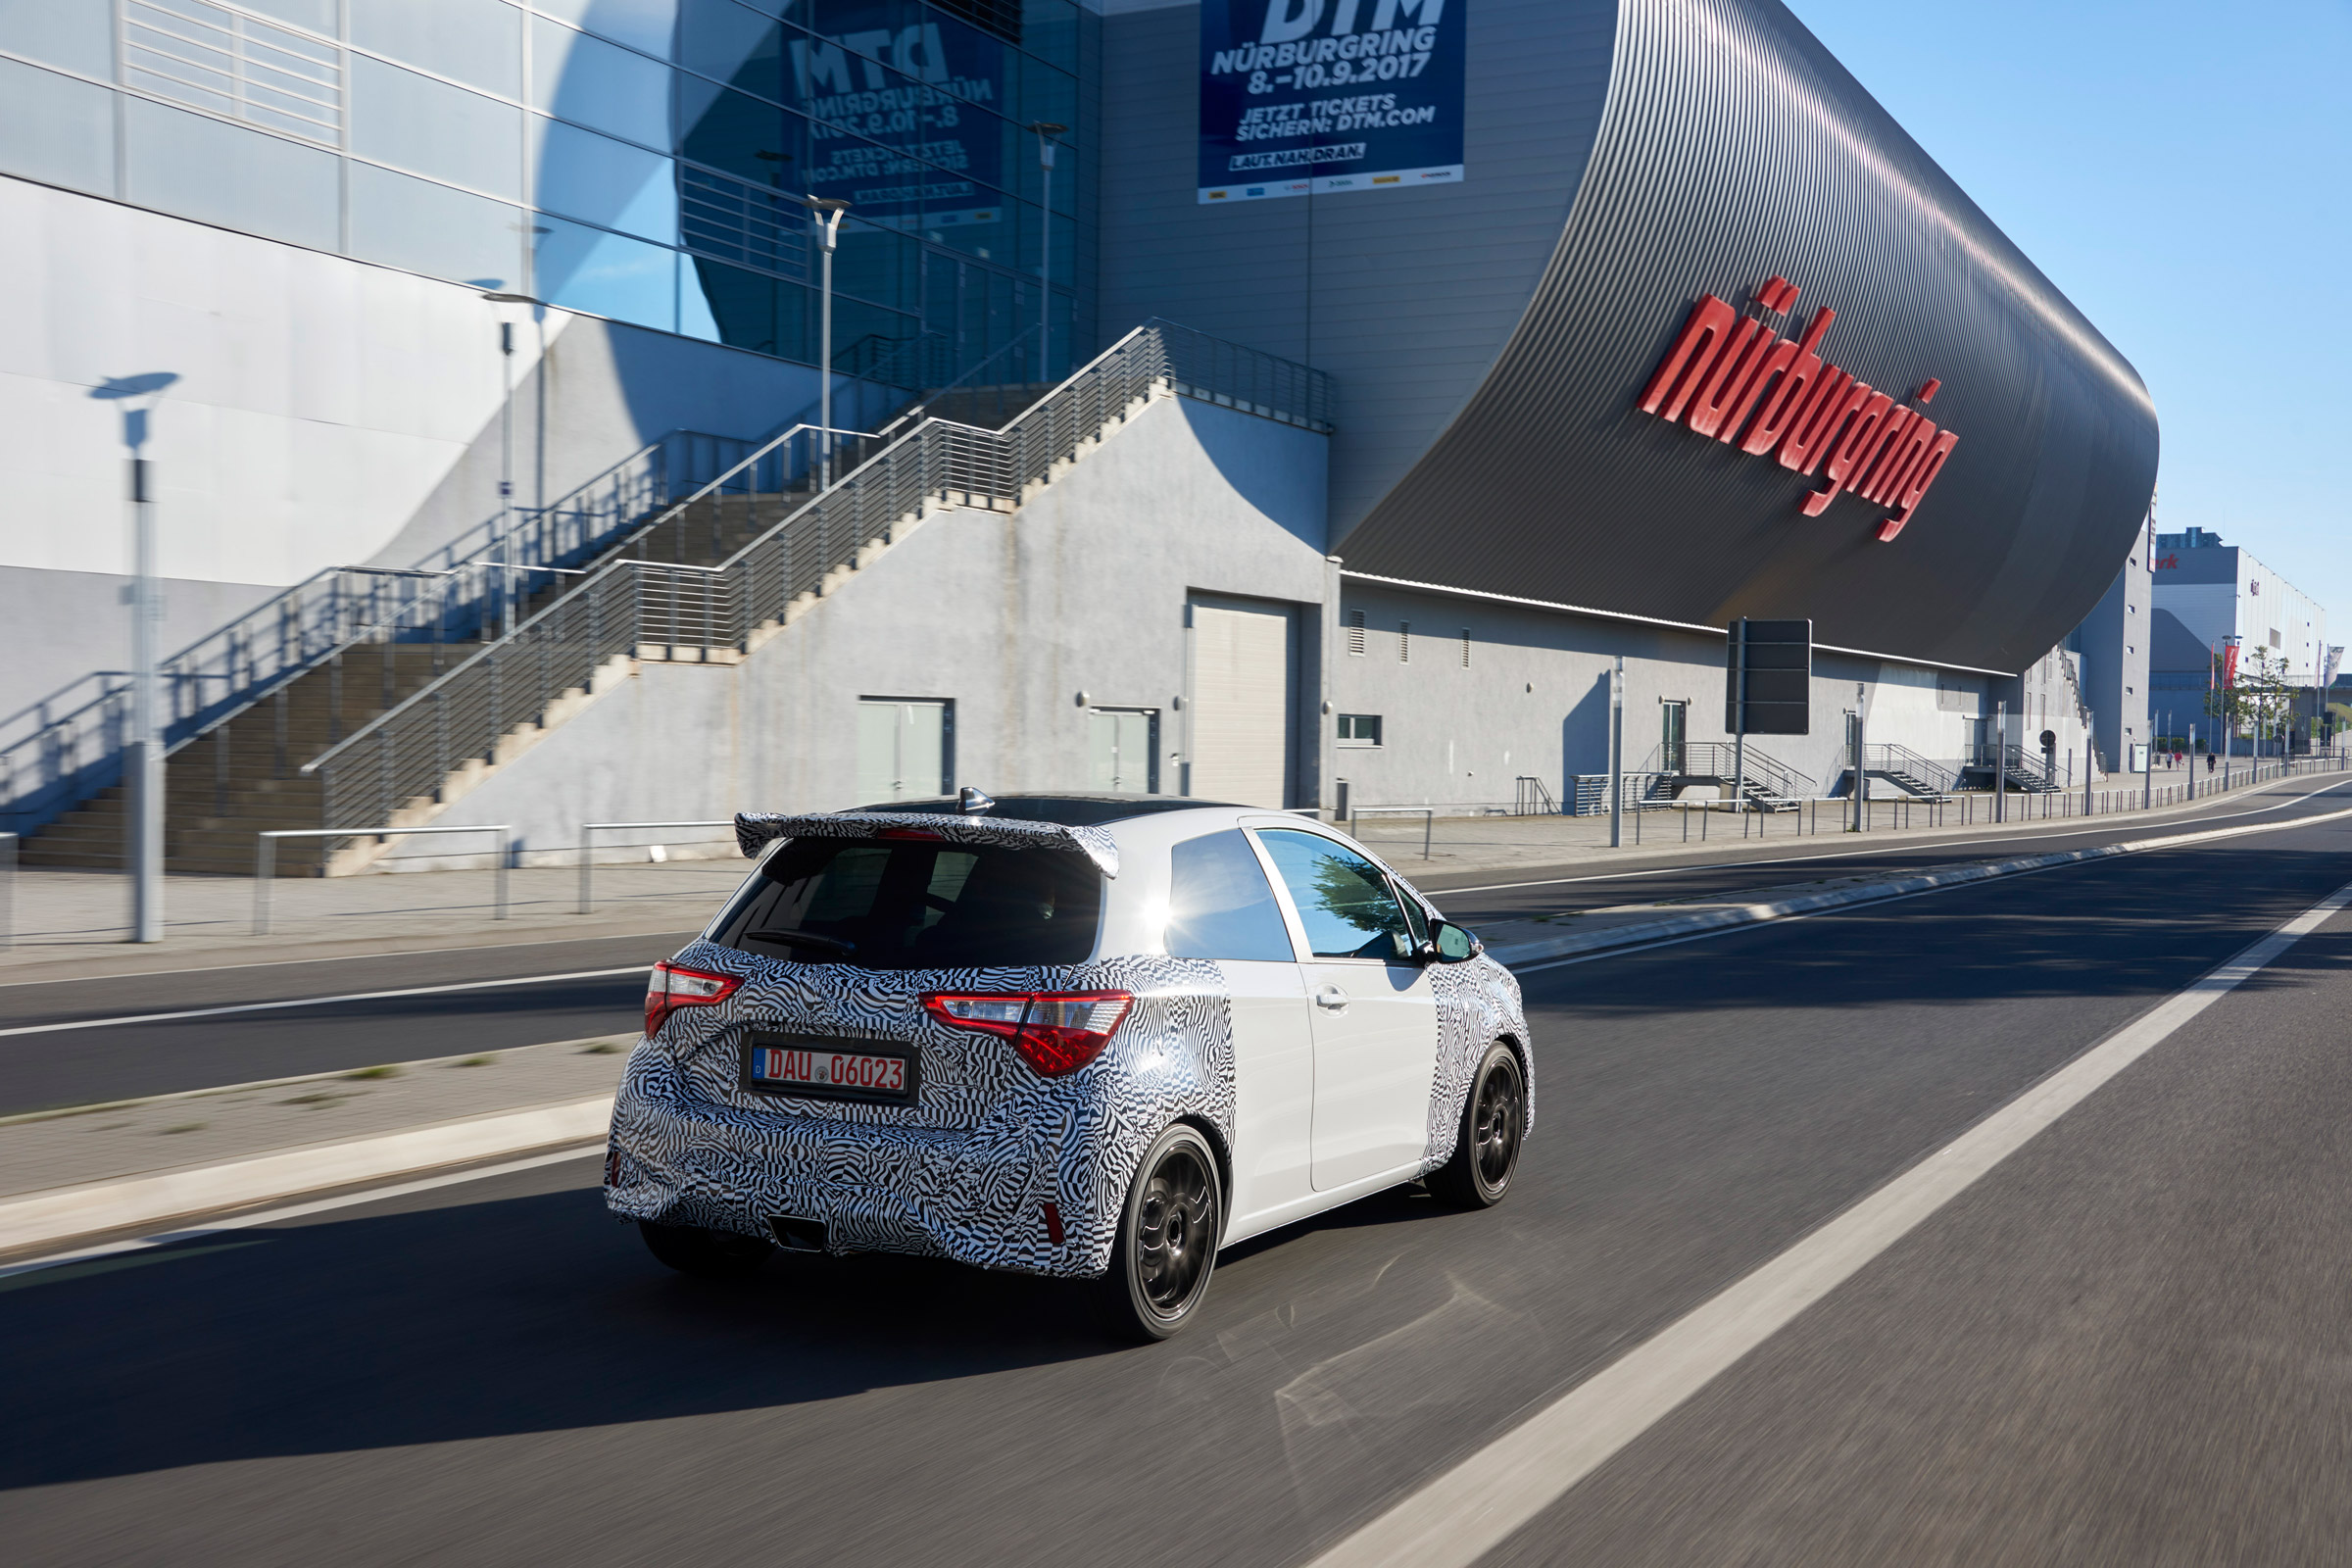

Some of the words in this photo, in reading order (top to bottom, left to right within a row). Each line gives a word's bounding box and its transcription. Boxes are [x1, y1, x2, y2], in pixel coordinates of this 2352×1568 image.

[1210, 25, 1438, 75] NÜRBURGRING
[1235, 117, 1333, 142] SICHERN:
[1336, 105, 1437, 132] DTM.COM
[1239, 103, 1304, 126] JETZT
[1308, 93, 1396, 119] TICKETS
[769, 1049, 812, 1082] DAU
[830, 1054, 904, 1090] 06023
